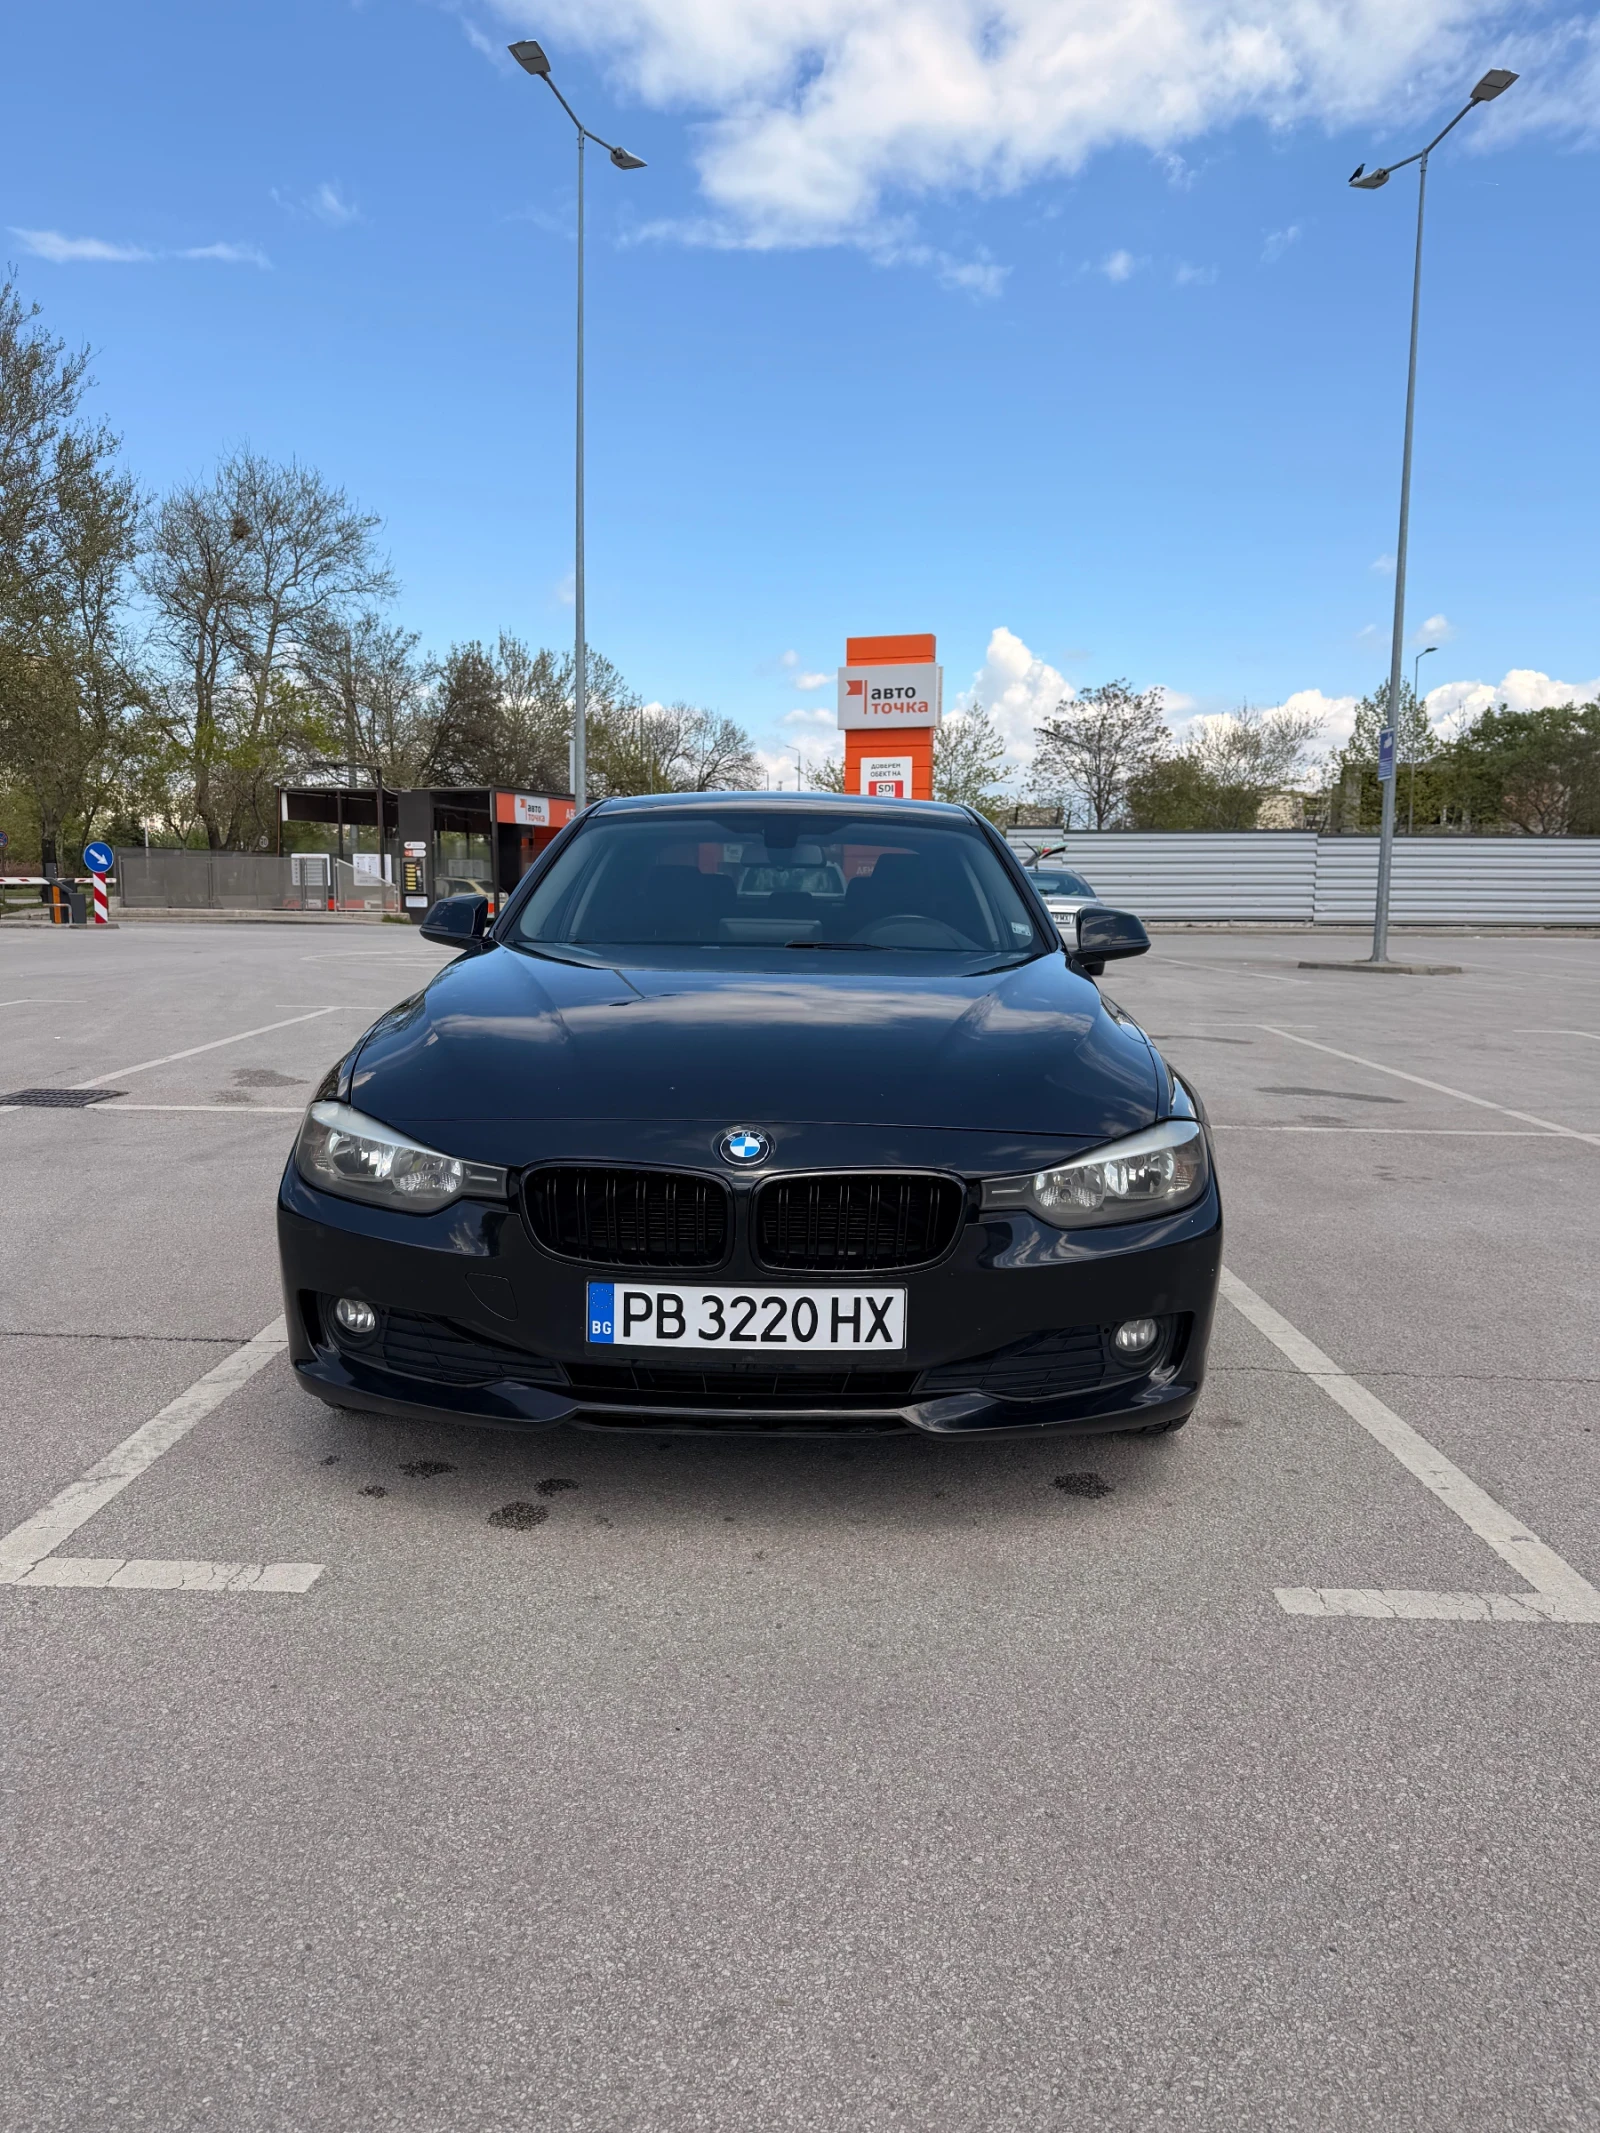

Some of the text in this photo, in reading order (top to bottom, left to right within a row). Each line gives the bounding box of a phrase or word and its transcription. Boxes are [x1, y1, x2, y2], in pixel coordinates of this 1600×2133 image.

[870, 686, 916, 700] авто
[871, 701, 928, 715] точка
[878, 784, 894, 793] SDI
[727, 1131, 764, 1142] BMW
[622, 1291, 894, 1343] PB 3220 HX
[591, 1321, 612, 1335] BG
